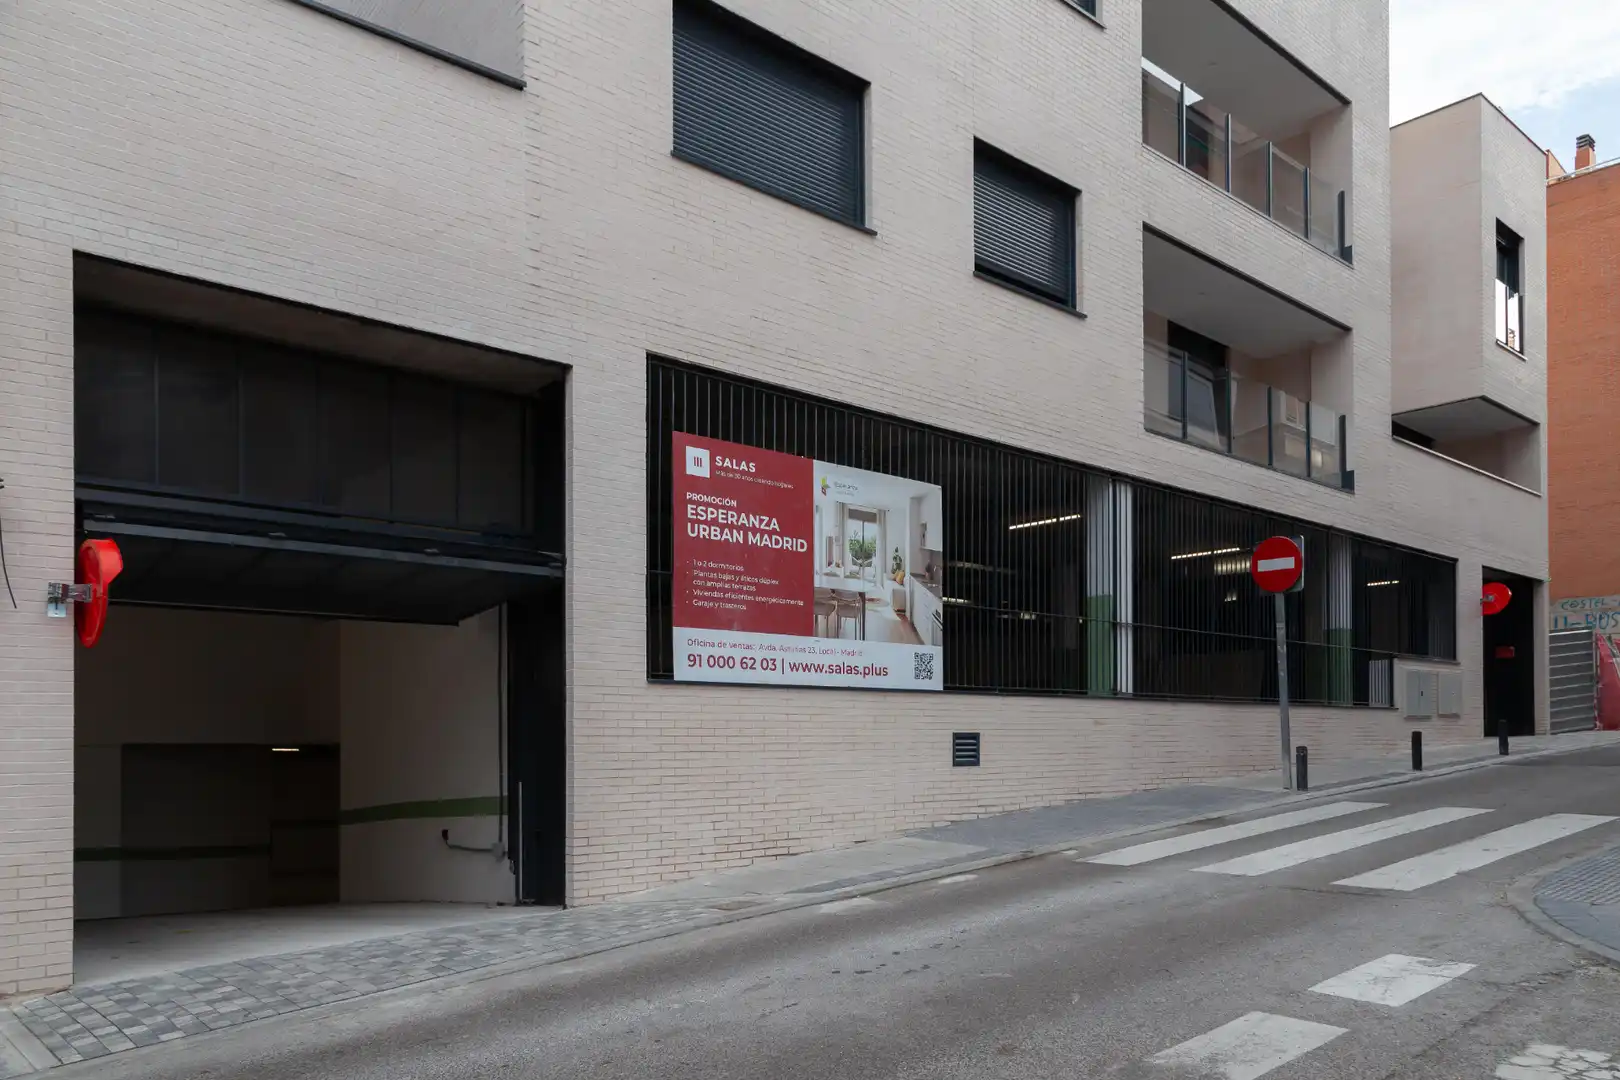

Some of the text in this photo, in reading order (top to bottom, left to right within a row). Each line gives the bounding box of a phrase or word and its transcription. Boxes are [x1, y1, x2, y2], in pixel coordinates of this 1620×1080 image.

[715, 456, 756, 472] SALAS
[686, 492, 736, 507] PROMOCIÓN
[687, 504, 780, 532] ESPERANZA
[687, 522, 808, 552] URBAN MADRID
[708, 561, 744, 572] dormitorios
[694, 570, 717, 578] Plantas
[718, 572, 734, 581] bajas
[707, 580, 731, 589] amplias
[732, 583, 756, 591] terrazas
[693, 589, 724, 598] Viviendas
[725, 591, 754, 601] eficientes
[693, 600, 714, 608] Garaje
[720, 602, 746, 610] trasteros
[687, 638, 715, 648] Oficina
[808, 646, 818, 655] 23,
[687, 653, 702, 668] 91
[707, 655, 736, 669] 000
[740, 656, 756, 670] 62
[760, 658, 777, 671] 03
[789, 662, 888, 678] www.salas.plus
